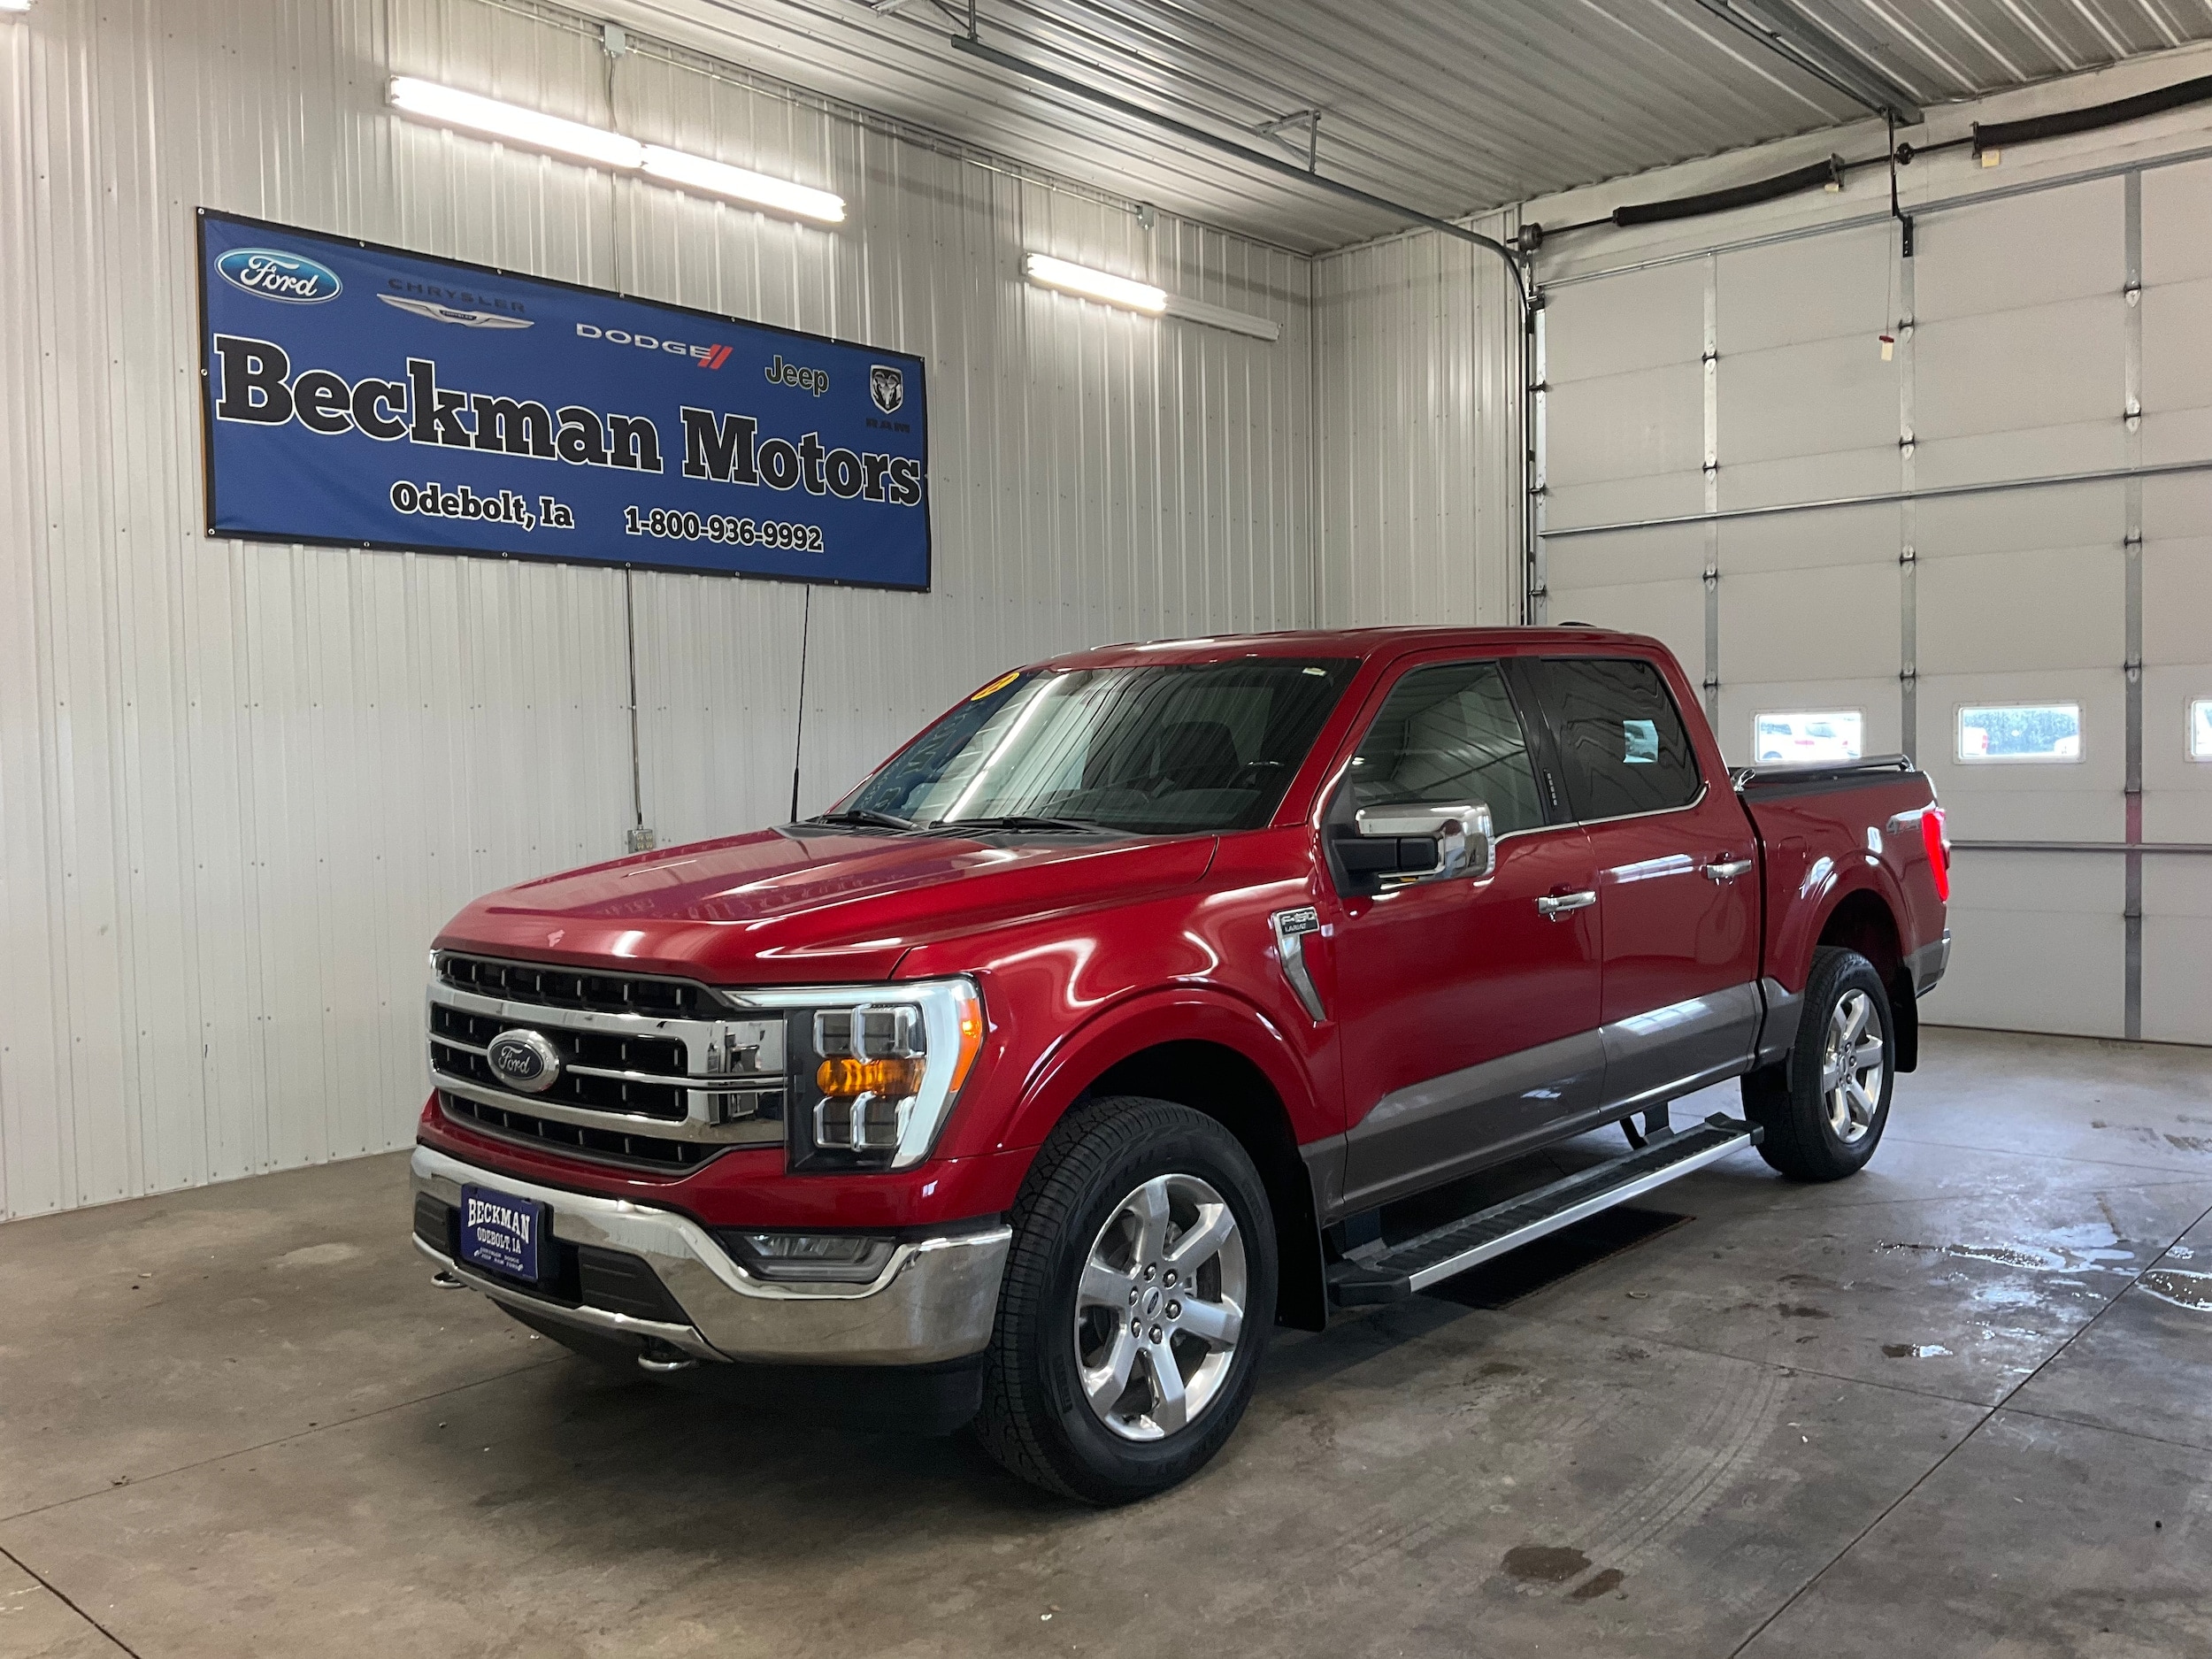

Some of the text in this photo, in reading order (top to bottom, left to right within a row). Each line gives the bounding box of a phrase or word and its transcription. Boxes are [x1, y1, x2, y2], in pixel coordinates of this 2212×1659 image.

[240, 256, 319, 297] Ford
[388, 278, 525, 313] CHRYSLER
[576, 323, 711, 359] DODGE
[764, 355, 829, 396] Jeep
[213, 333, 921, 507] Beckman Motors
[866, 418, 910, 434] RAM
[389, 480, 575, 532] Odebolt, Ia
[624, 505, 824, 553] 1-800-936-9992
[497, 1046, 531, 1075] Ford
[468, 1198, 530, 1244] BECKMAN
[477, 1226, 511, 1252] ODEBOLT,
[512, 1238, 521, 1254] IA
